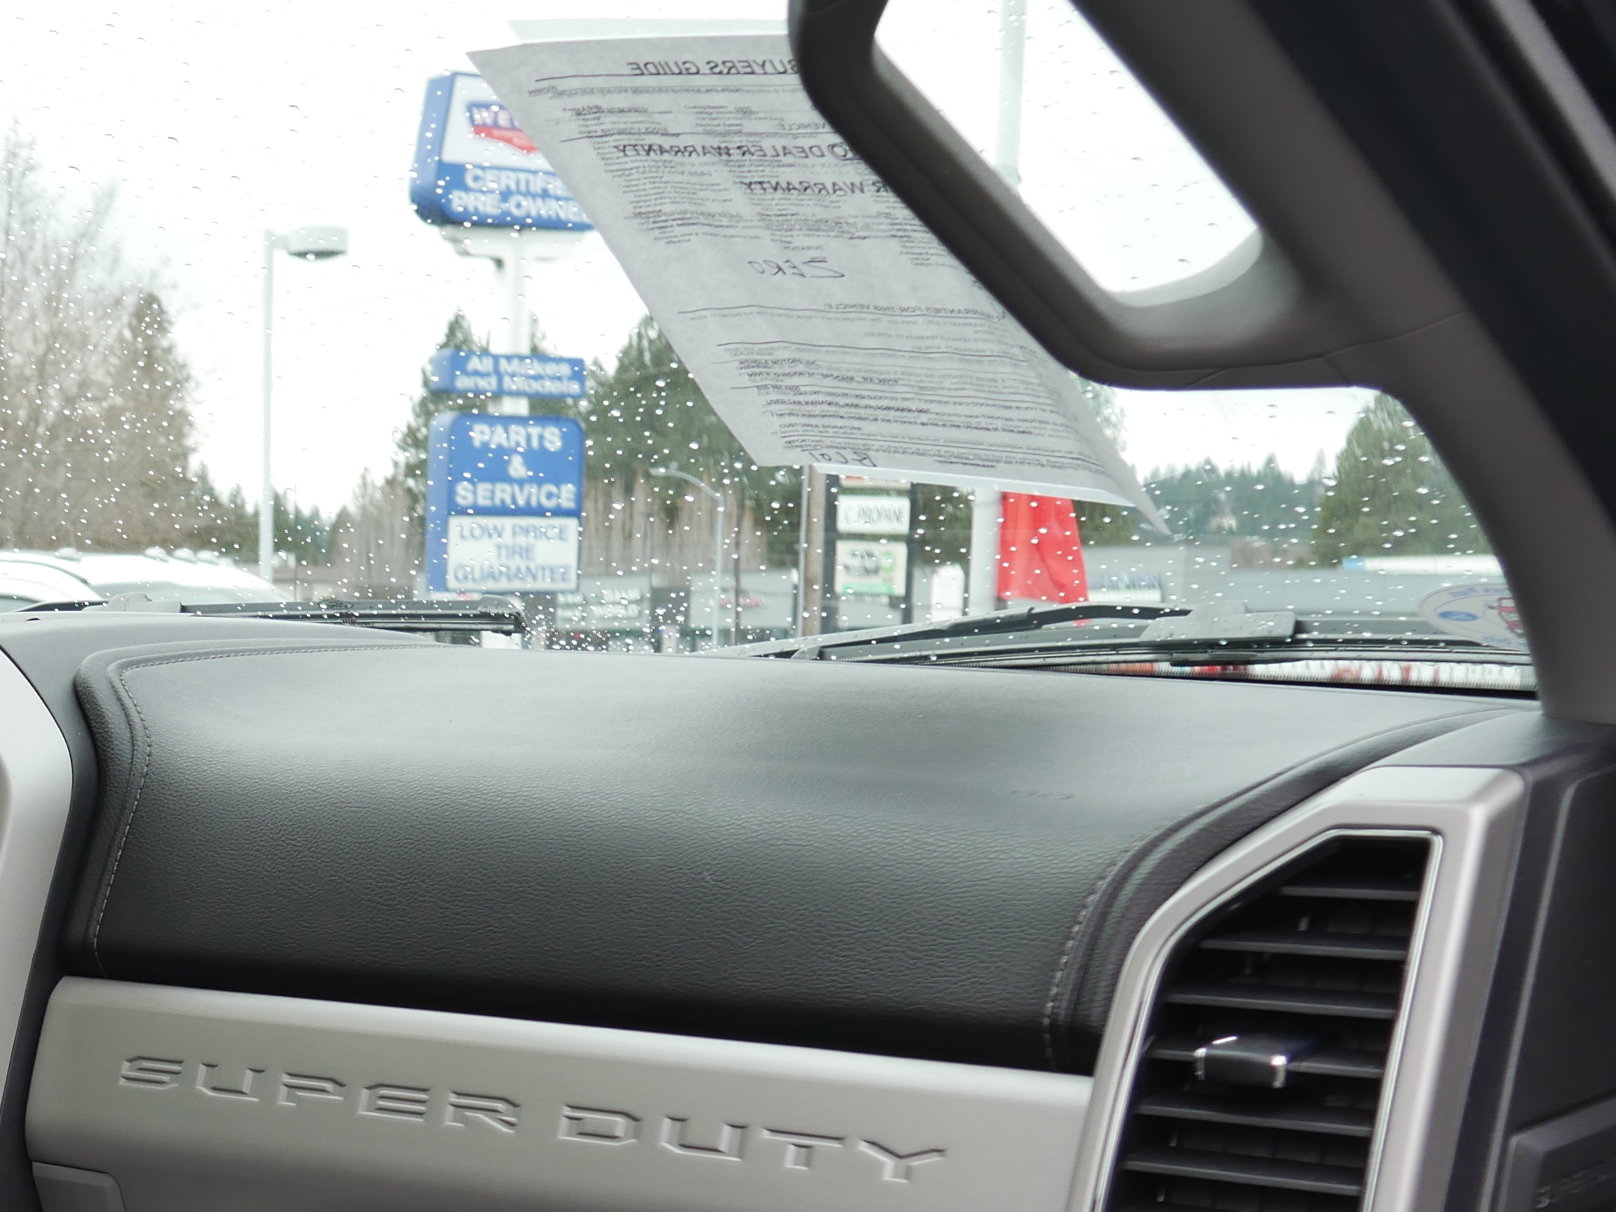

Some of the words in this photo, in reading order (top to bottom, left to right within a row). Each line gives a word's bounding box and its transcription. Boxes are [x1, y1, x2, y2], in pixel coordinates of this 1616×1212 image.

[472, 423, 563, 451] PARTS
[508, 454, 530, 479] &
[455, 481, 577, 509] SERVICE
[459, 522, 505, 541] LOW
[511, 523, 569, 542] PRICE
[495, 544, 536, 561] TIRE
[453, 563, 573, 584] GUARANTEE
[118, 1055, 521, 1134] SUPER
[557, 1102, 948, 1184] DUTY
